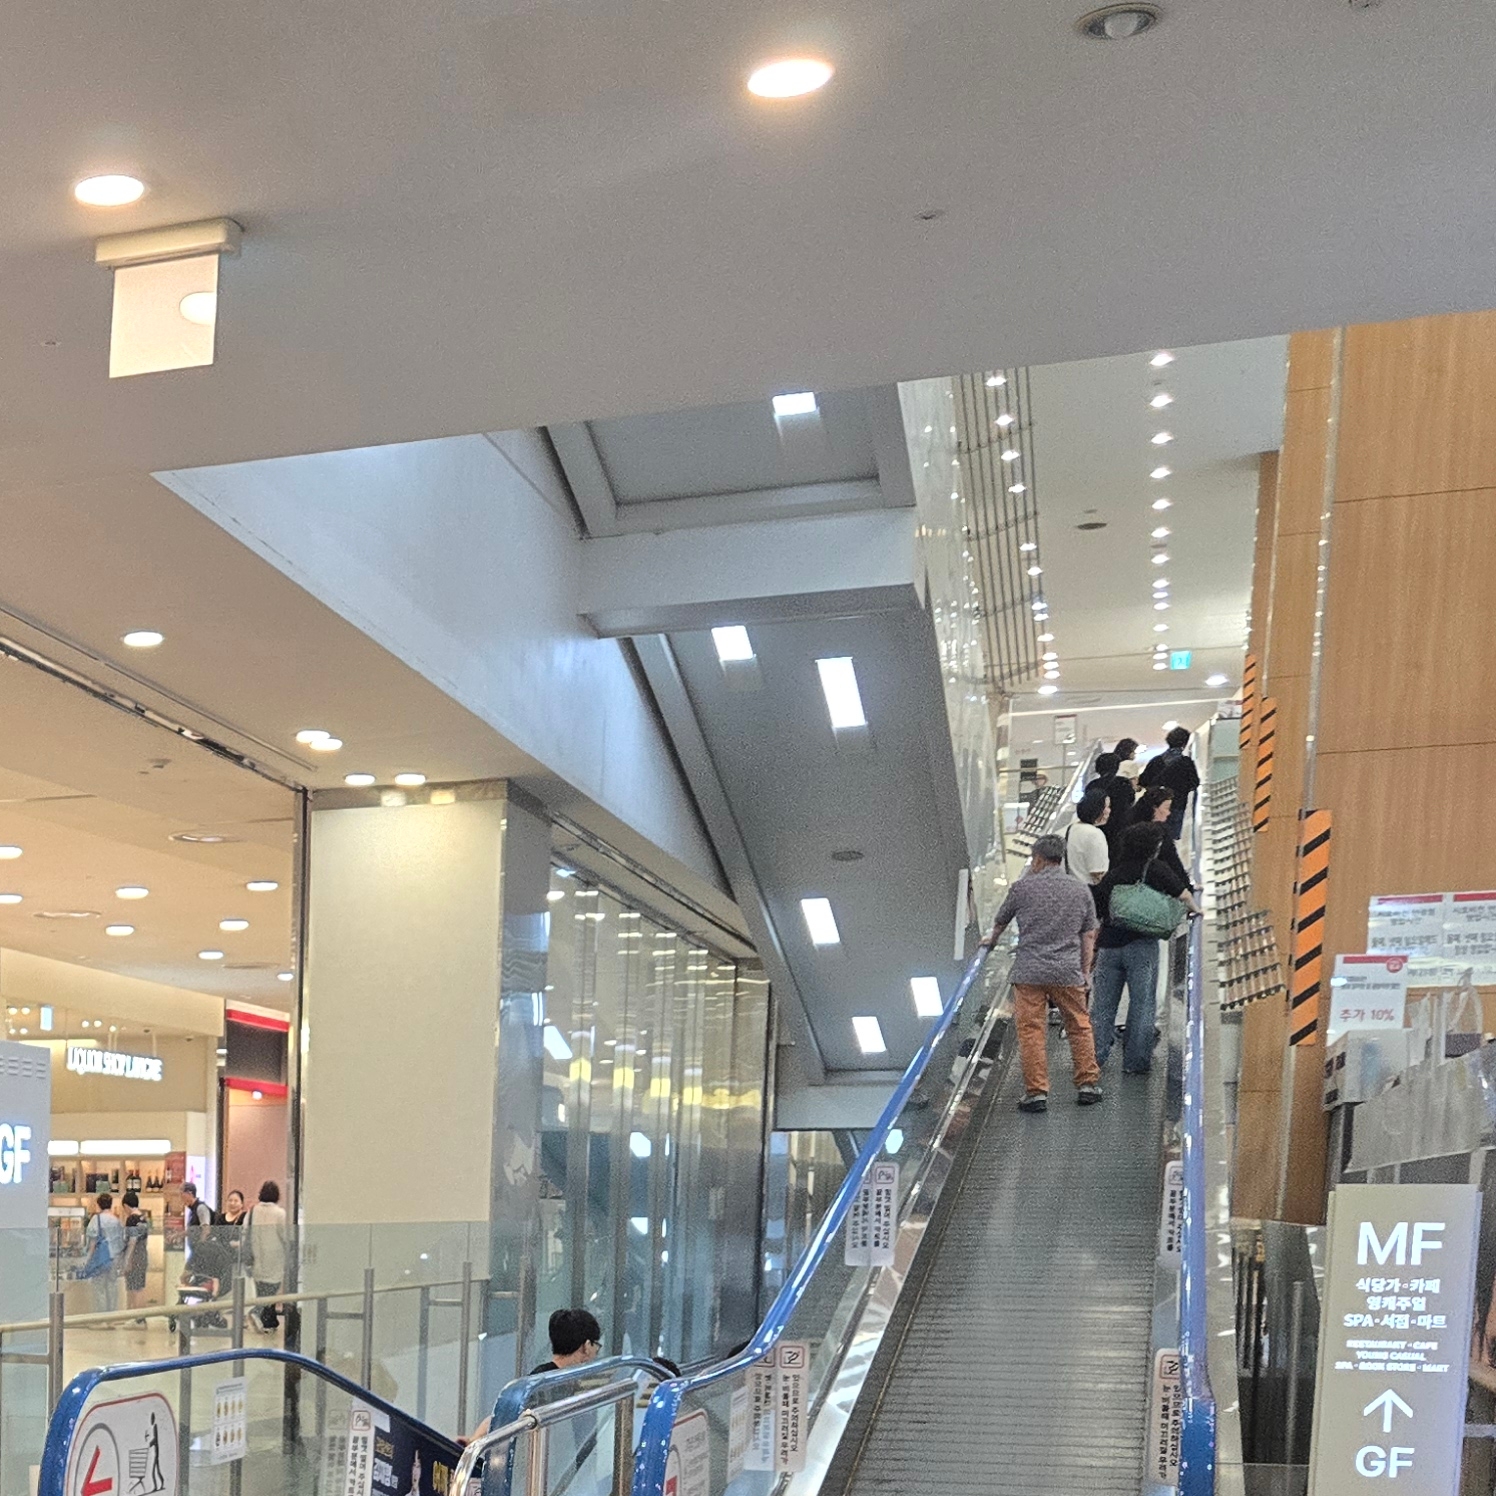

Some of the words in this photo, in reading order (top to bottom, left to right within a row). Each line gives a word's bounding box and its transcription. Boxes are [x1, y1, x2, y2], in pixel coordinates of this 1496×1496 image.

[1340, 1008, 1366, 1023] 추가
[1371, 1008, 1395, 1022] 10%
[1356, 1221, 1445, 1266] MF
[1354, 1445, 1415, 1479] GF
